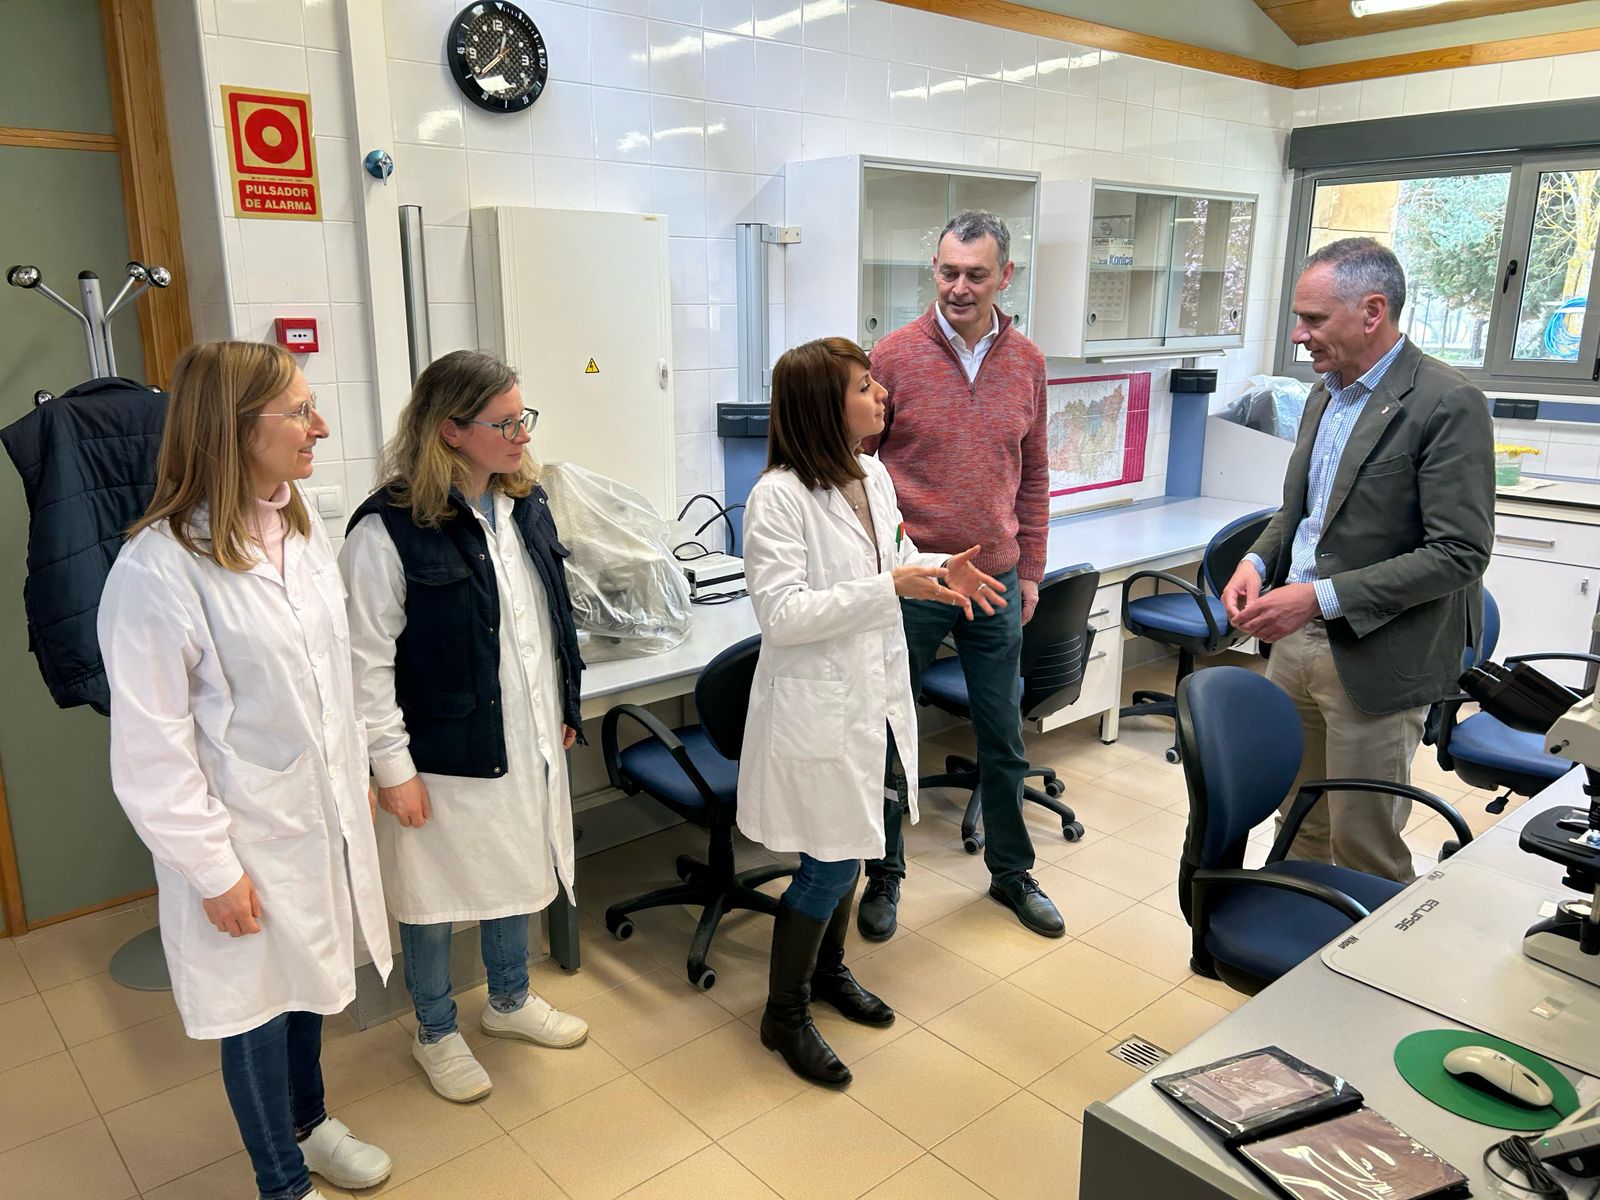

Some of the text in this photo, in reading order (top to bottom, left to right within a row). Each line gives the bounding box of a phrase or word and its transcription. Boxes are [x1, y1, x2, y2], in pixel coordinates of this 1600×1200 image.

[493, 19, 503, 31] 12
[469, 48, 477, 59] 9
[521, 55, 529, 66] 3
[245, 184, 309, 197] PULSADOR
[245, 198, 312, 211] DE ALARMA
[1109, 254, 1133, 265] Konica
[1394, 899, 1439, 931] ECLIPSE
[1338, 935, 1359, 949] Nikon
